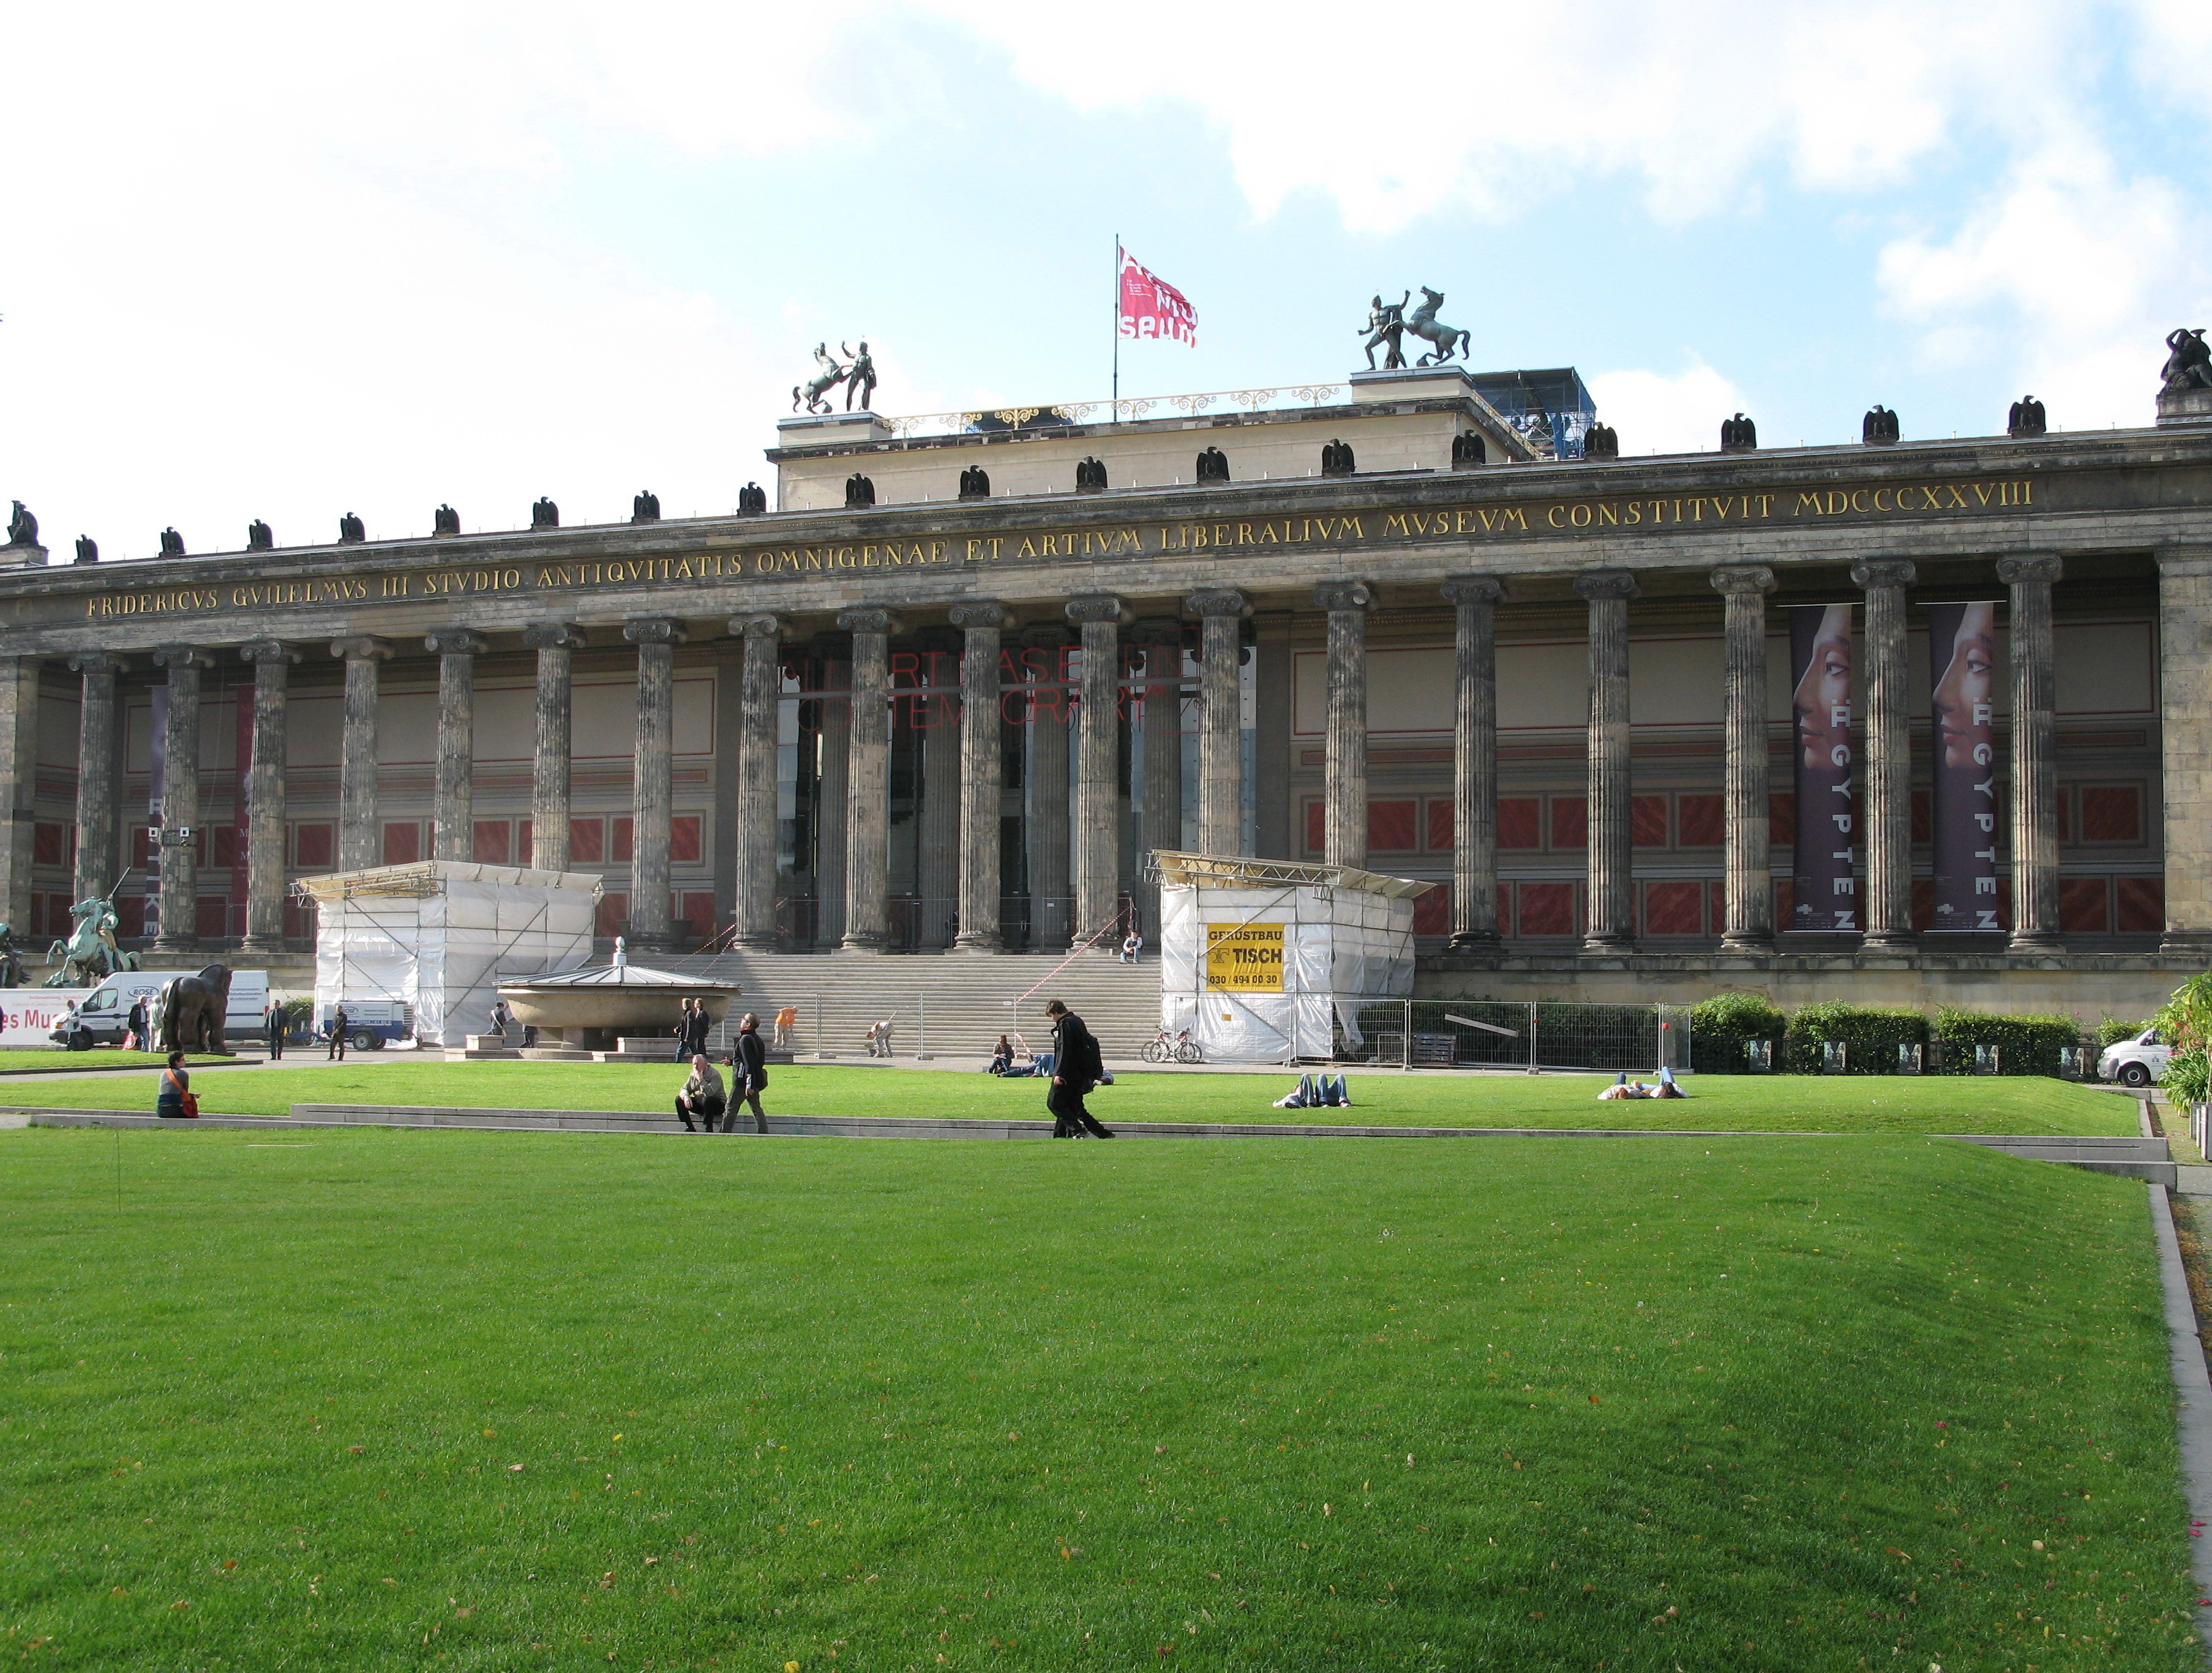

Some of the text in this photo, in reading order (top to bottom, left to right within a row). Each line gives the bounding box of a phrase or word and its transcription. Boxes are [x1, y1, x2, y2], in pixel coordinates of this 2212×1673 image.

[88, 481, 2033, 616] FRIDERICVS GVILELMVS III STVDIO ANTIQVITATIS OMNIGENAE ET ARTIVM LIBERALIVM MVSEVM CONSTITVIT MDCCCXXVIII
[1232, 948, 1282, 964] TISCH
[1210, 975, 1226, 984] 030
[1233, 975, 1250, 984] 494
[1253, 975, 1263, 983] 00
[1266, 975, 1277, 983] 30
